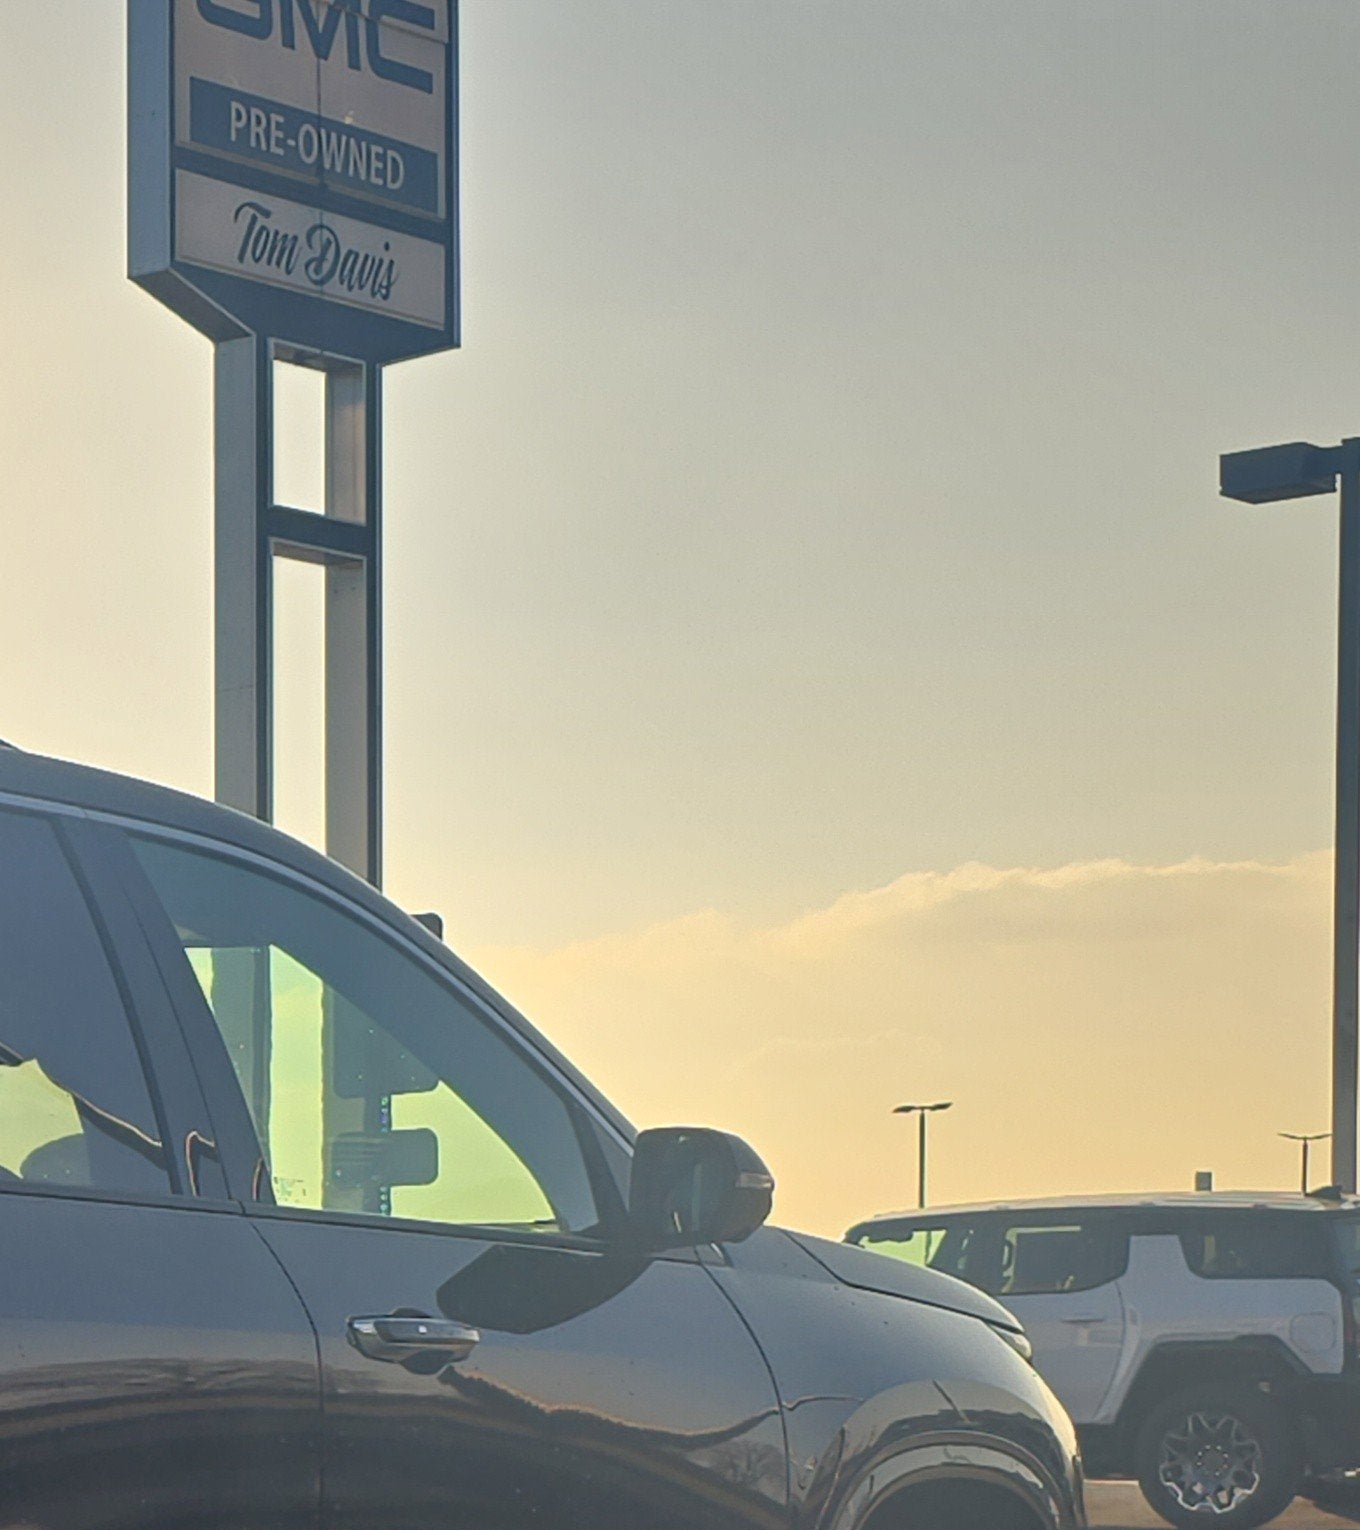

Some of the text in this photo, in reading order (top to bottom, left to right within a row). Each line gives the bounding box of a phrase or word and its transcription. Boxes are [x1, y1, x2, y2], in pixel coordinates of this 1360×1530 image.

[230, 101, 404, 190] PRE-OWNED
[233, 202, 401, 300] Tom Davis
